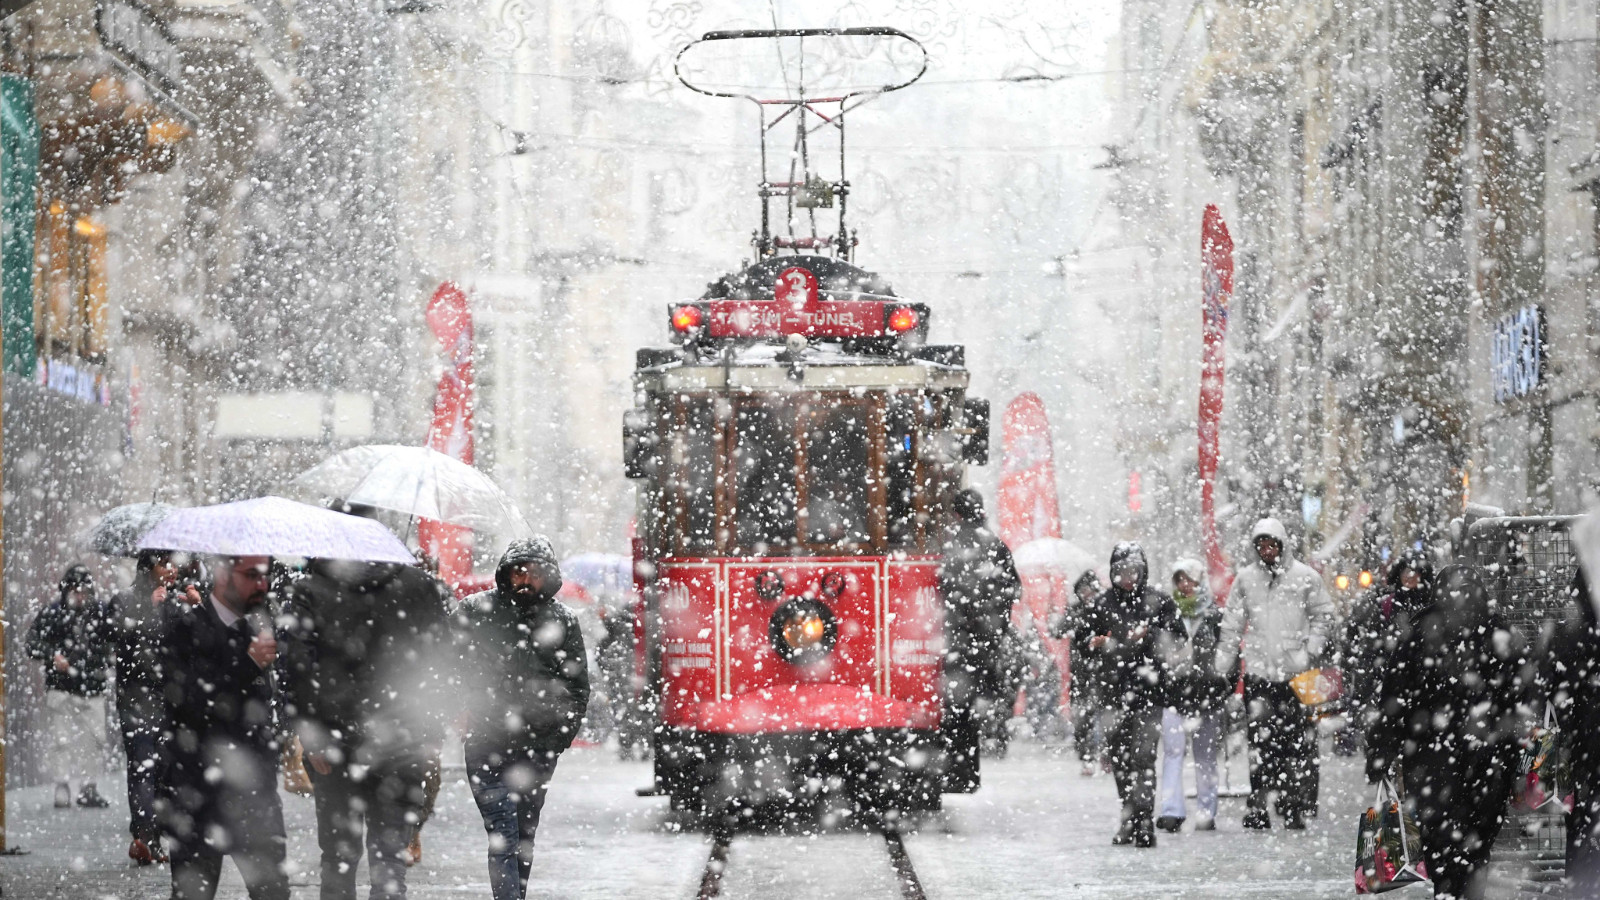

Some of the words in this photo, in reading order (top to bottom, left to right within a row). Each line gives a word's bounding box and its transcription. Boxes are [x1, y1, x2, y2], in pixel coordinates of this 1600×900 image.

[786, 271, 807, 302] 3
[717, 310, 781, 326] TASİM
[805, 310, 858, 326] TÜNEL
